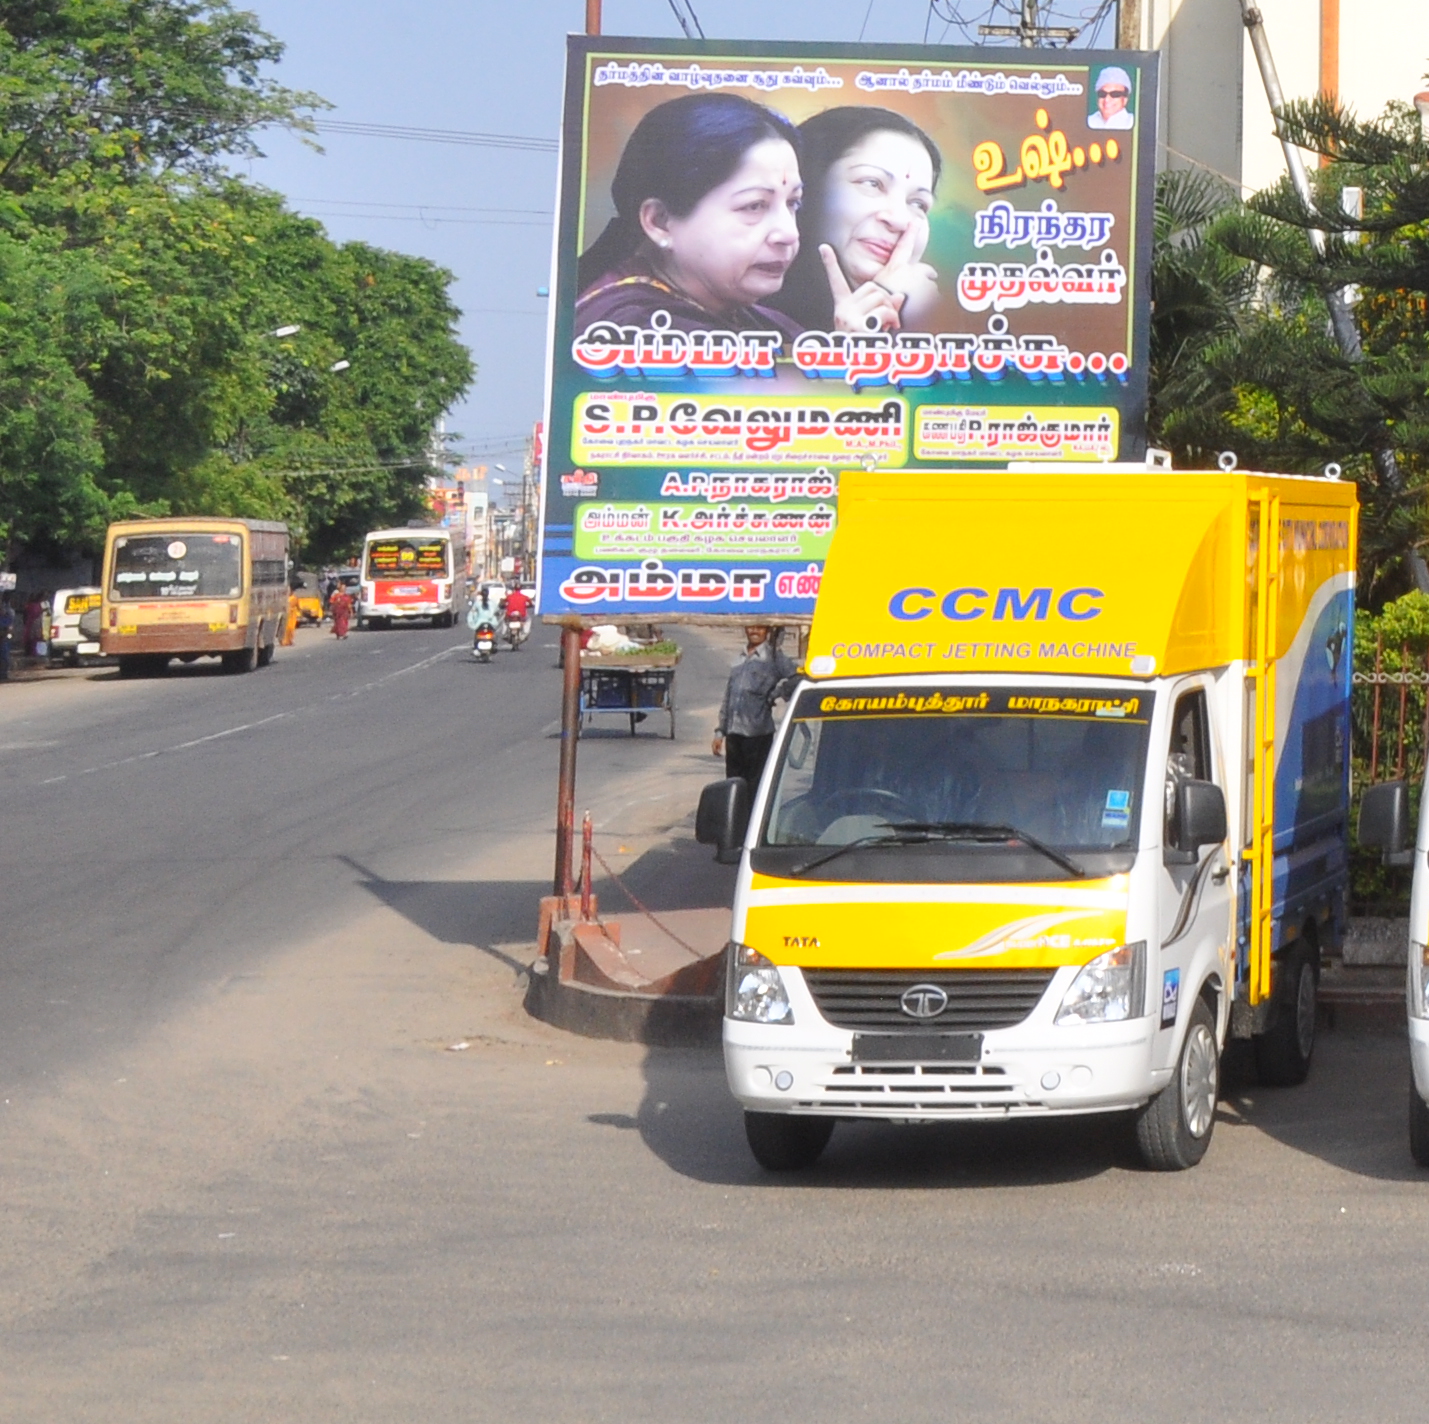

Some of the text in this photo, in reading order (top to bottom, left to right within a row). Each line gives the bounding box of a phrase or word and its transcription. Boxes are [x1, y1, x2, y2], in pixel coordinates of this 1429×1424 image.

[978, 202, 1111, 245] நிரந்தர
[575, 312, 780, 369] அம்மா
[563, 561, 767, 600] அம்மா
[888, 587, 1106, 621] CCMC
[831, 641, 1138, 660] COMPACT JETTING MACHINE
[783, 936, 820, 948] TATA
